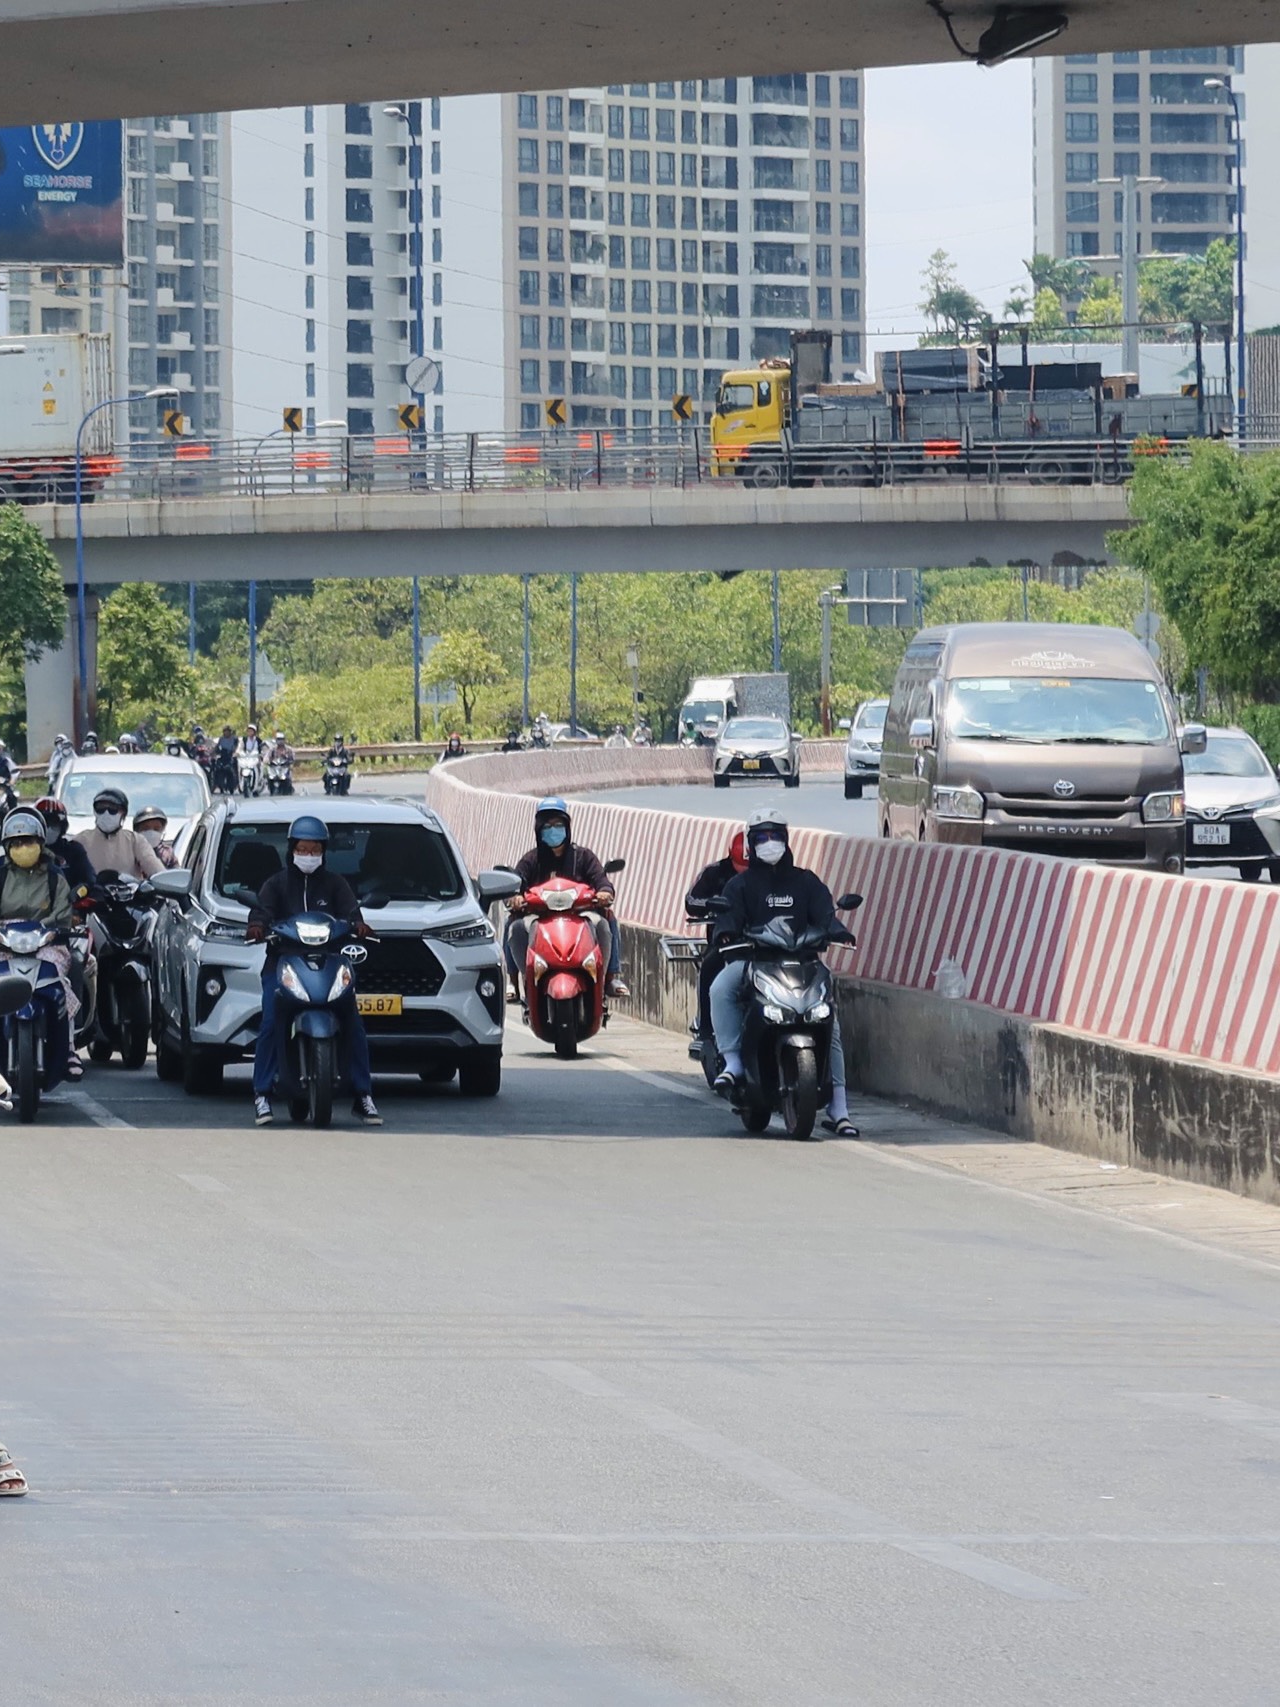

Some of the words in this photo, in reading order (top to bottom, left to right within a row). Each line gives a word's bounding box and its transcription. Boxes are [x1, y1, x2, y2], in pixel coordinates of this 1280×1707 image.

[23, 174, 93, 189] SEAHORSE
[38, 190, 77, 202] ENERGY
[1018, 824, 1114, 836] DISCOVERY
